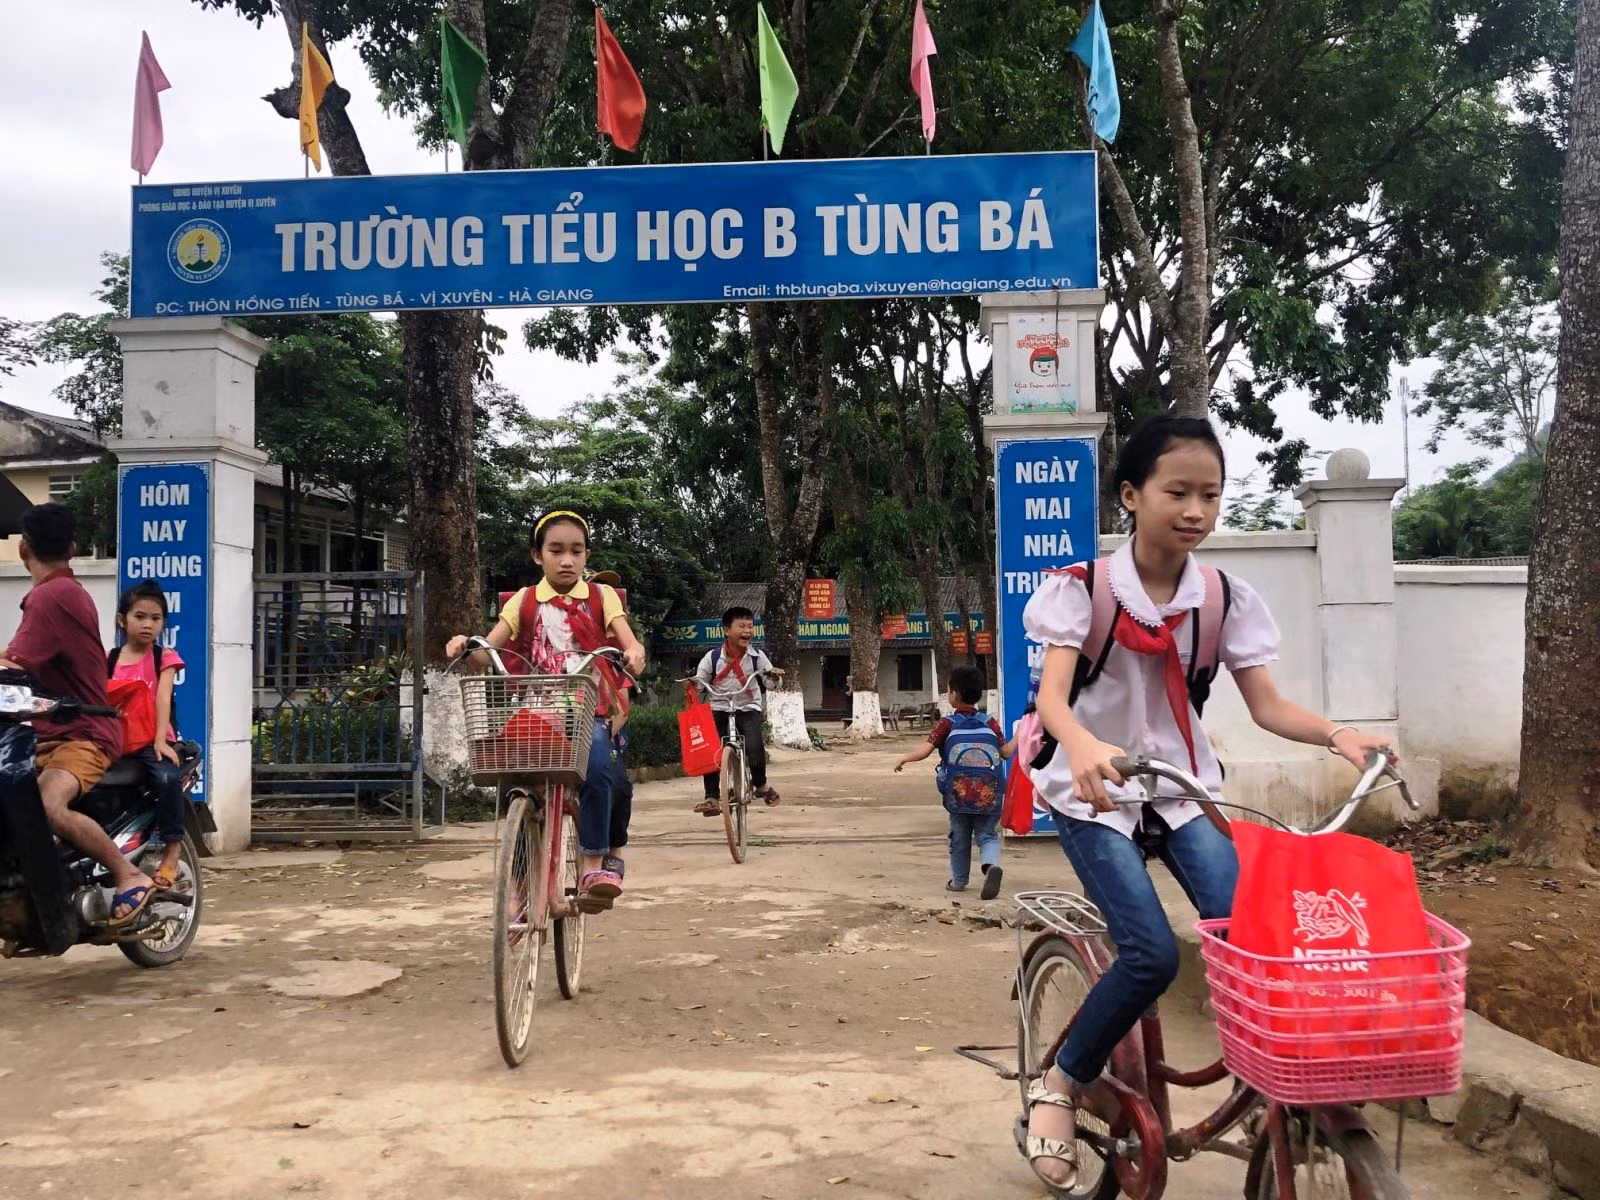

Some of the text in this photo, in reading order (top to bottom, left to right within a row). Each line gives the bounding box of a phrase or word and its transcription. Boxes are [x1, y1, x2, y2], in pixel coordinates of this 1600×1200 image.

[275, 205, 484, 272] TRƯỜNG
[501, 191, 617, 265] TIỂU
[636, 208, 743, 272] HỌC
[763, 207, 797, 259] B
[815, 193, 959, 256] TÙNG
[979, 187, 1054, 251] BÁ
[155, 302, 184, 314] ĐC:
[188, 298, 231, 313] THÔN
[288, 292, 320, 309] TIẾN
[335, 292, 379, 307] TÙNG
[383, 291, 404, 306] BÁ
[420, 291, 436, 306] VỊ
[441, 289, 493, 304] XUYÊN
[509, 286, 532, 302] HÀ
[537, 288, 594, 301] GIANG
[723, 277, 1071, 298] Email: thbtungba.vixuyen@hagiang.edu.vn
[1015, 457, 1079, 484] NGÀY
[139, 480, 190, 507] HÔM
[1025, 497, 1071, 520] MAI
[143, 519, 187, 542] NAY
[1024, 529, 1074, 557] NHÀ
[127, 552, 202, 579] CHÚNG
[820, 623, 849, 636] NGOAN
